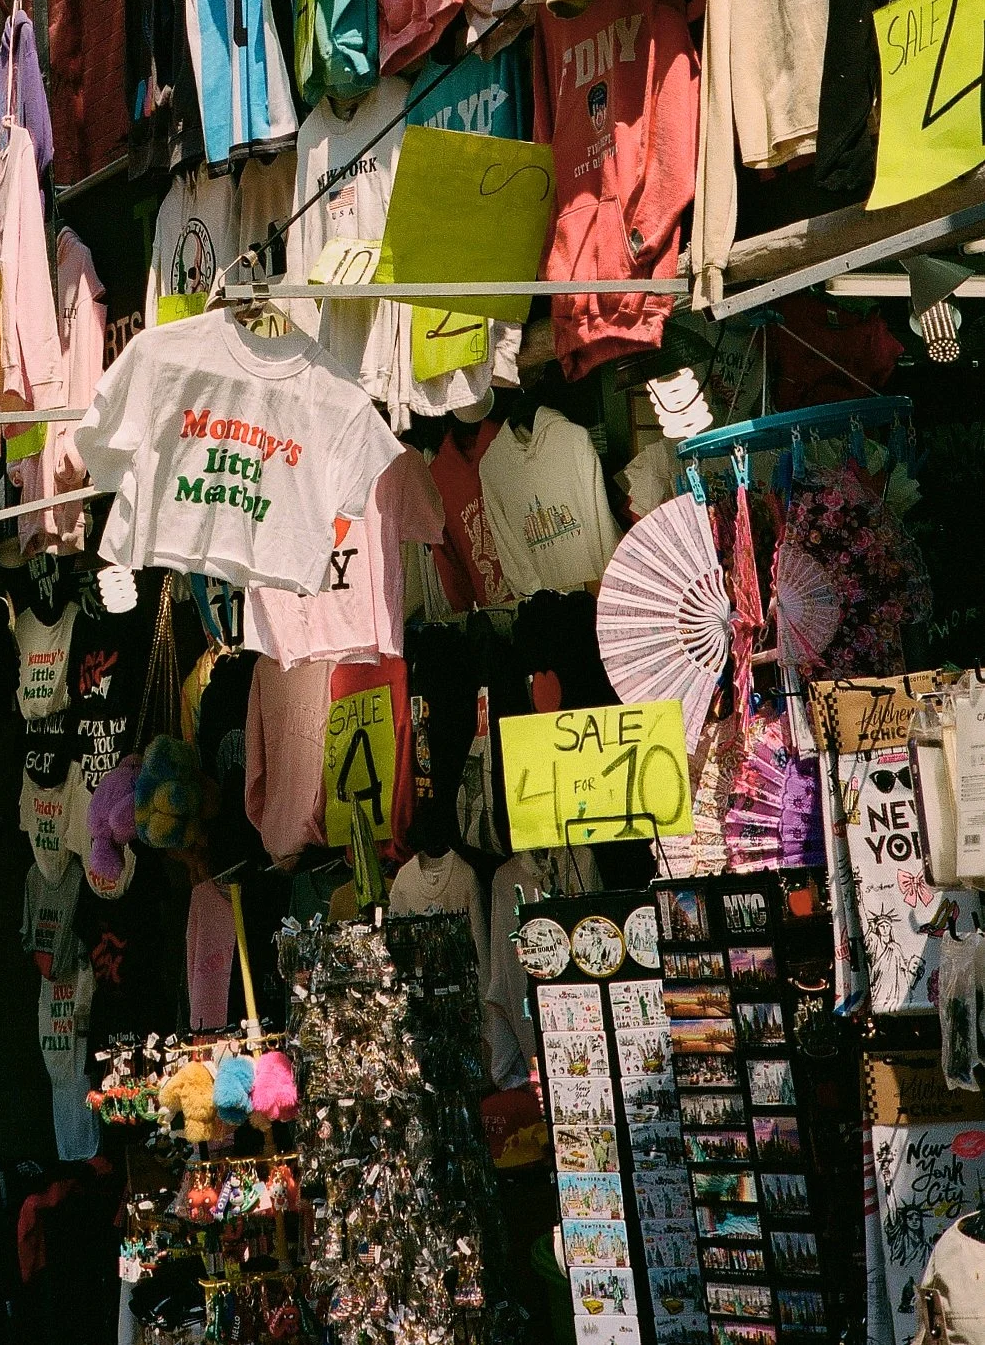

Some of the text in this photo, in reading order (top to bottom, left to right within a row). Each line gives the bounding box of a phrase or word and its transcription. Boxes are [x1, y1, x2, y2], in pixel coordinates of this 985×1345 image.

[103, 310, 143, 366] RTS
[328, 694, 384, 736] SALE
[555, 710, 644, 753] SALE
[93, 735, 115, 755] YOU
[573, 776, 596, 794] FOR
[866, 800, 918, 833] NE
[722, 893, 767, 929] NYC
[906, 1130, 952, 1164] New
[911, 1153, 966, 1192] York
[921, 1180, 972, 1219] City
[231, 1315, 242, 1341] HELLO
